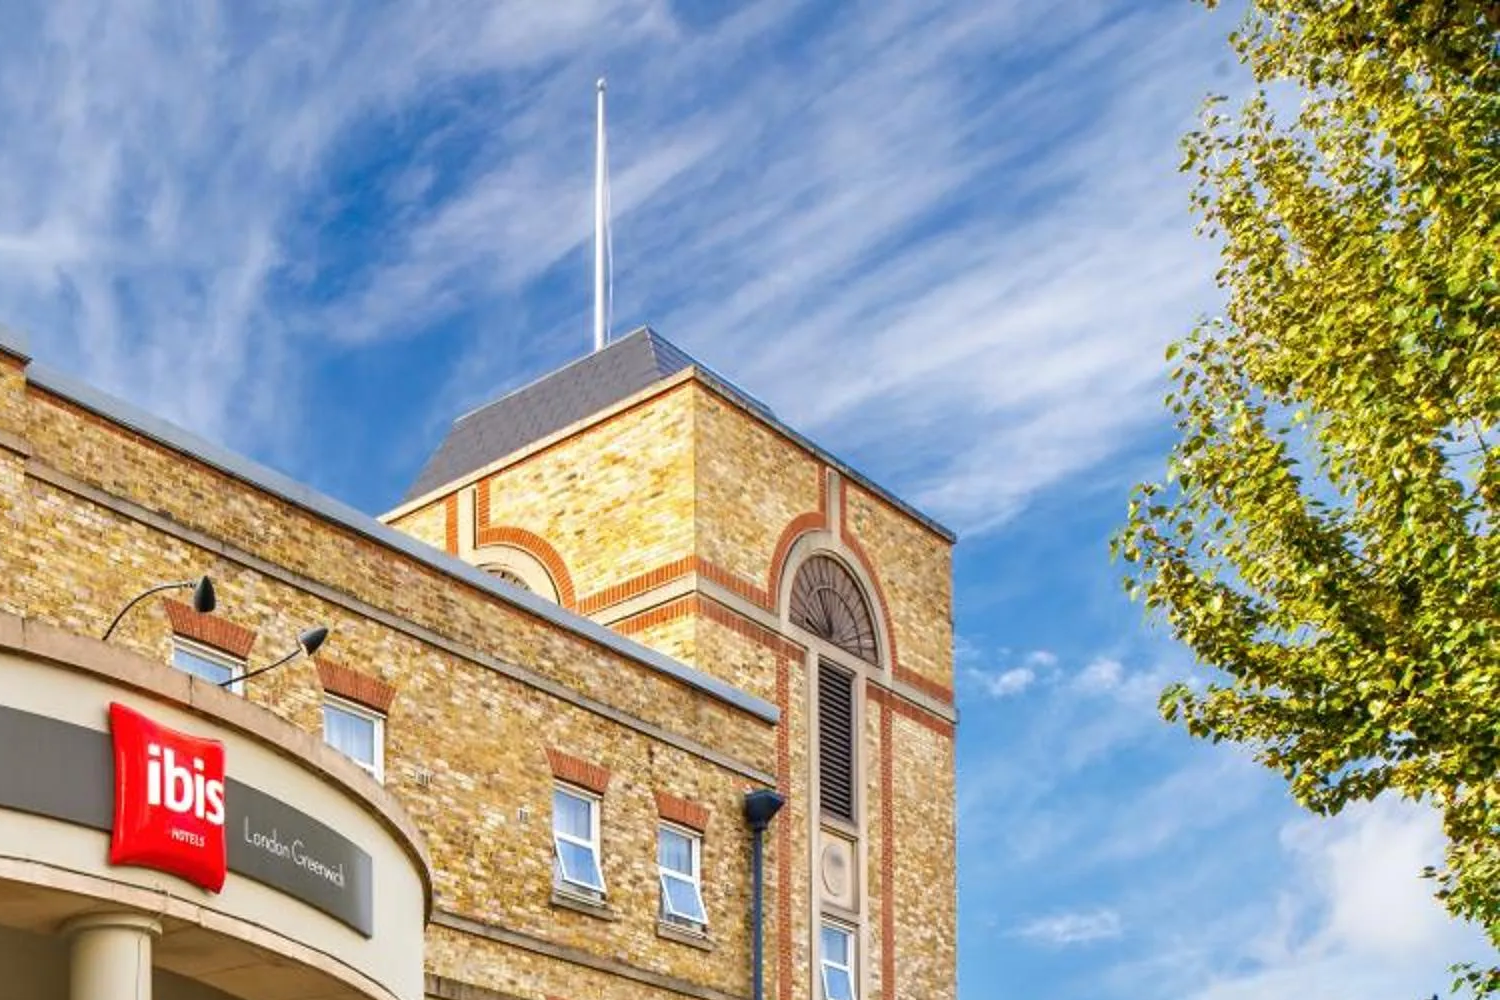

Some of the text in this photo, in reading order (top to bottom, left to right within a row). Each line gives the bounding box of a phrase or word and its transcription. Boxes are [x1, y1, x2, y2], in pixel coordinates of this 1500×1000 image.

[148, 743, 225, 825] ibis
[171, 828, 205, 847] HOTELS
[244, 815, 290, 859] London
